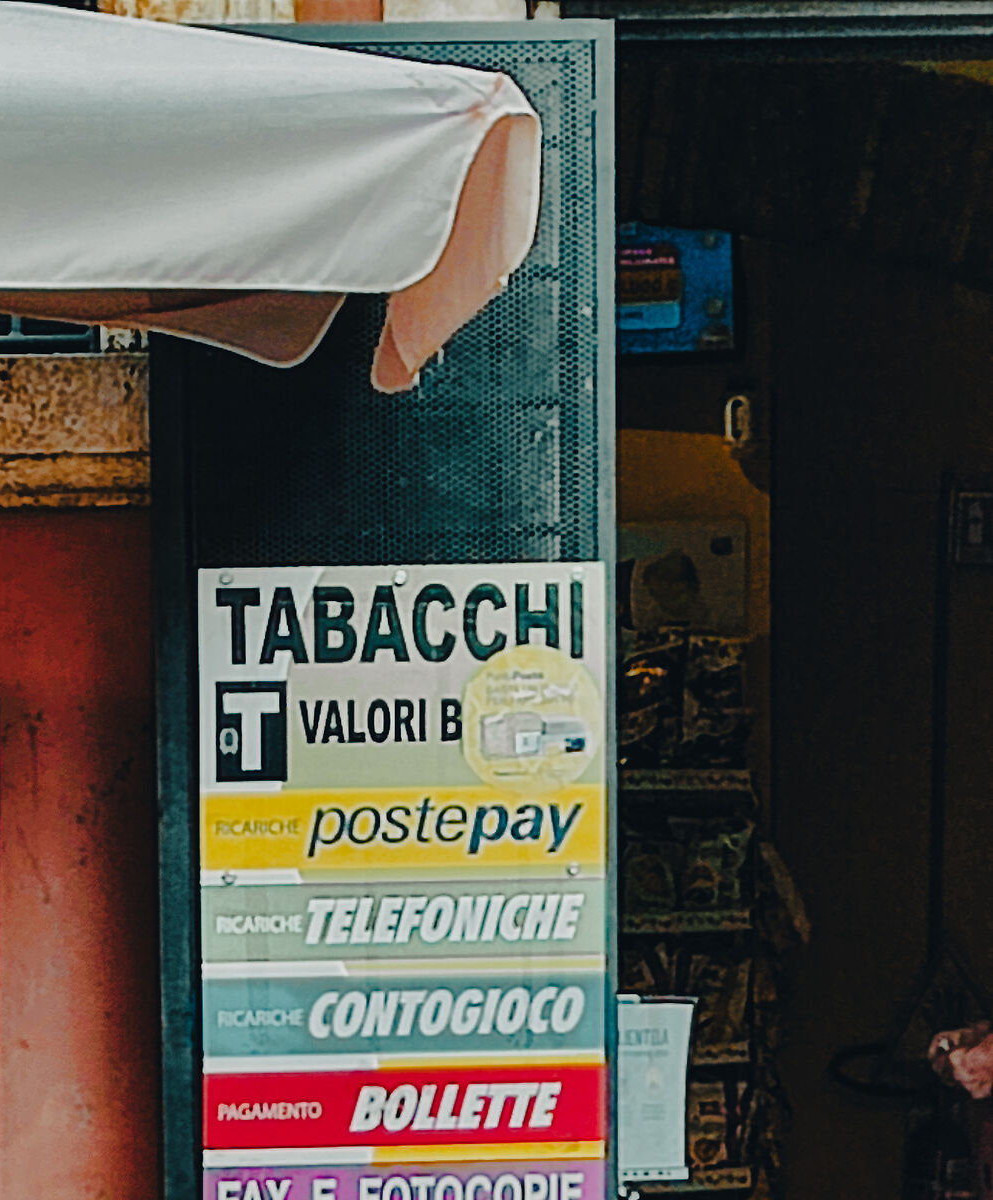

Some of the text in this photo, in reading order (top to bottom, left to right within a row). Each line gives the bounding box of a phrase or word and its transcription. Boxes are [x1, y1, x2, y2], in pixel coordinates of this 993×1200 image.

[216, 581, 583, 664] TABACCHI
[299, 698, 427, 744] VALORI
[214, 797, 584, 857] RICARICHE postepay
[216, 893, 585, 945] RICARICHE TELEFONICHE
[217, 986, 585, 1039] RICARICHE CONTOGIOCO
[217, 1081, 562, 1133] PAGAMENTO BOLLETTE
